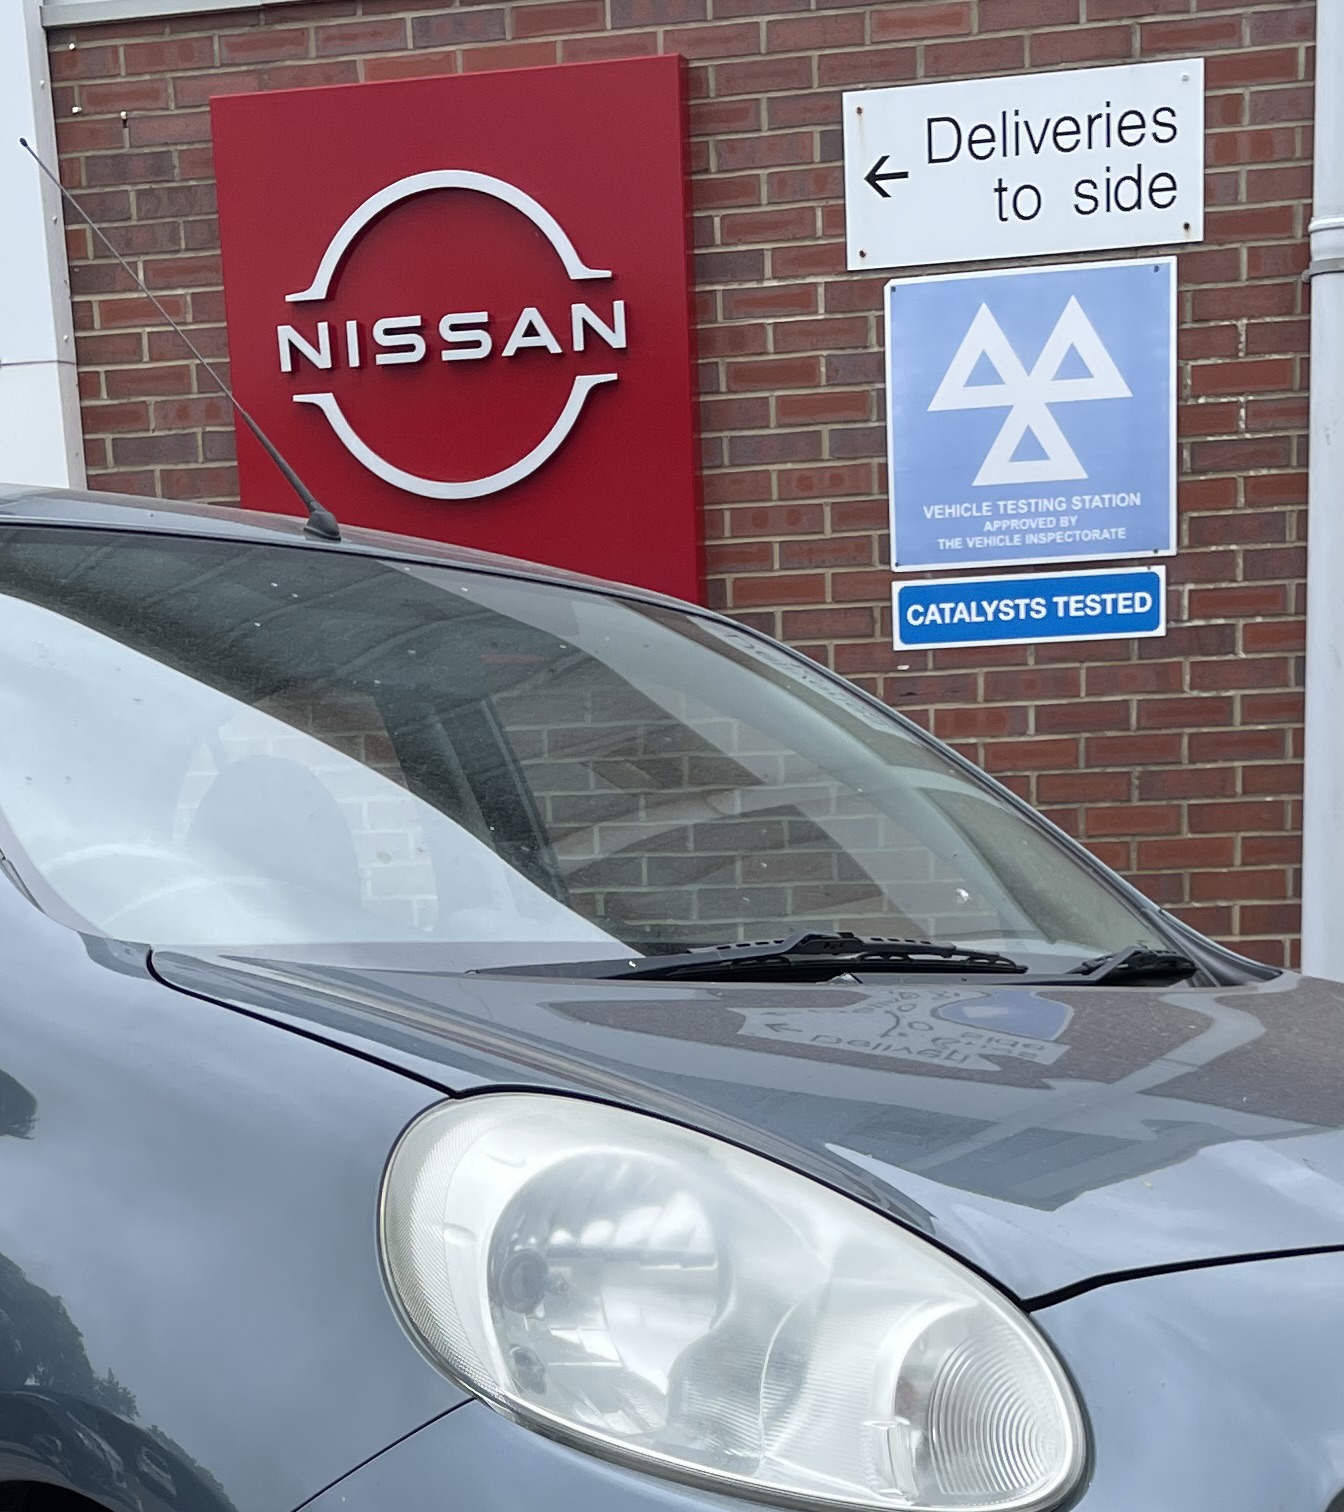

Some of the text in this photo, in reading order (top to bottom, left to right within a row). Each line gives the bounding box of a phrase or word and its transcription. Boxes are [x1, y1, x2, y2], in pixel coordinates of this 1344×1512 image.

[926, 100, 1178, 164] Deliveries
[993, 163, 1178, 222] to side
[276, 299, 627, 373] NISSAN
[922, 492, 1142, 520] VEHICLE TESTING STATION
[983, 515, 1078, 532] APPROVED BY
[937, 527, 1127, 550] THE VEHICLE INSPECTORATE
[906, 591, 1153, 626] CATALYSTS TESTED
